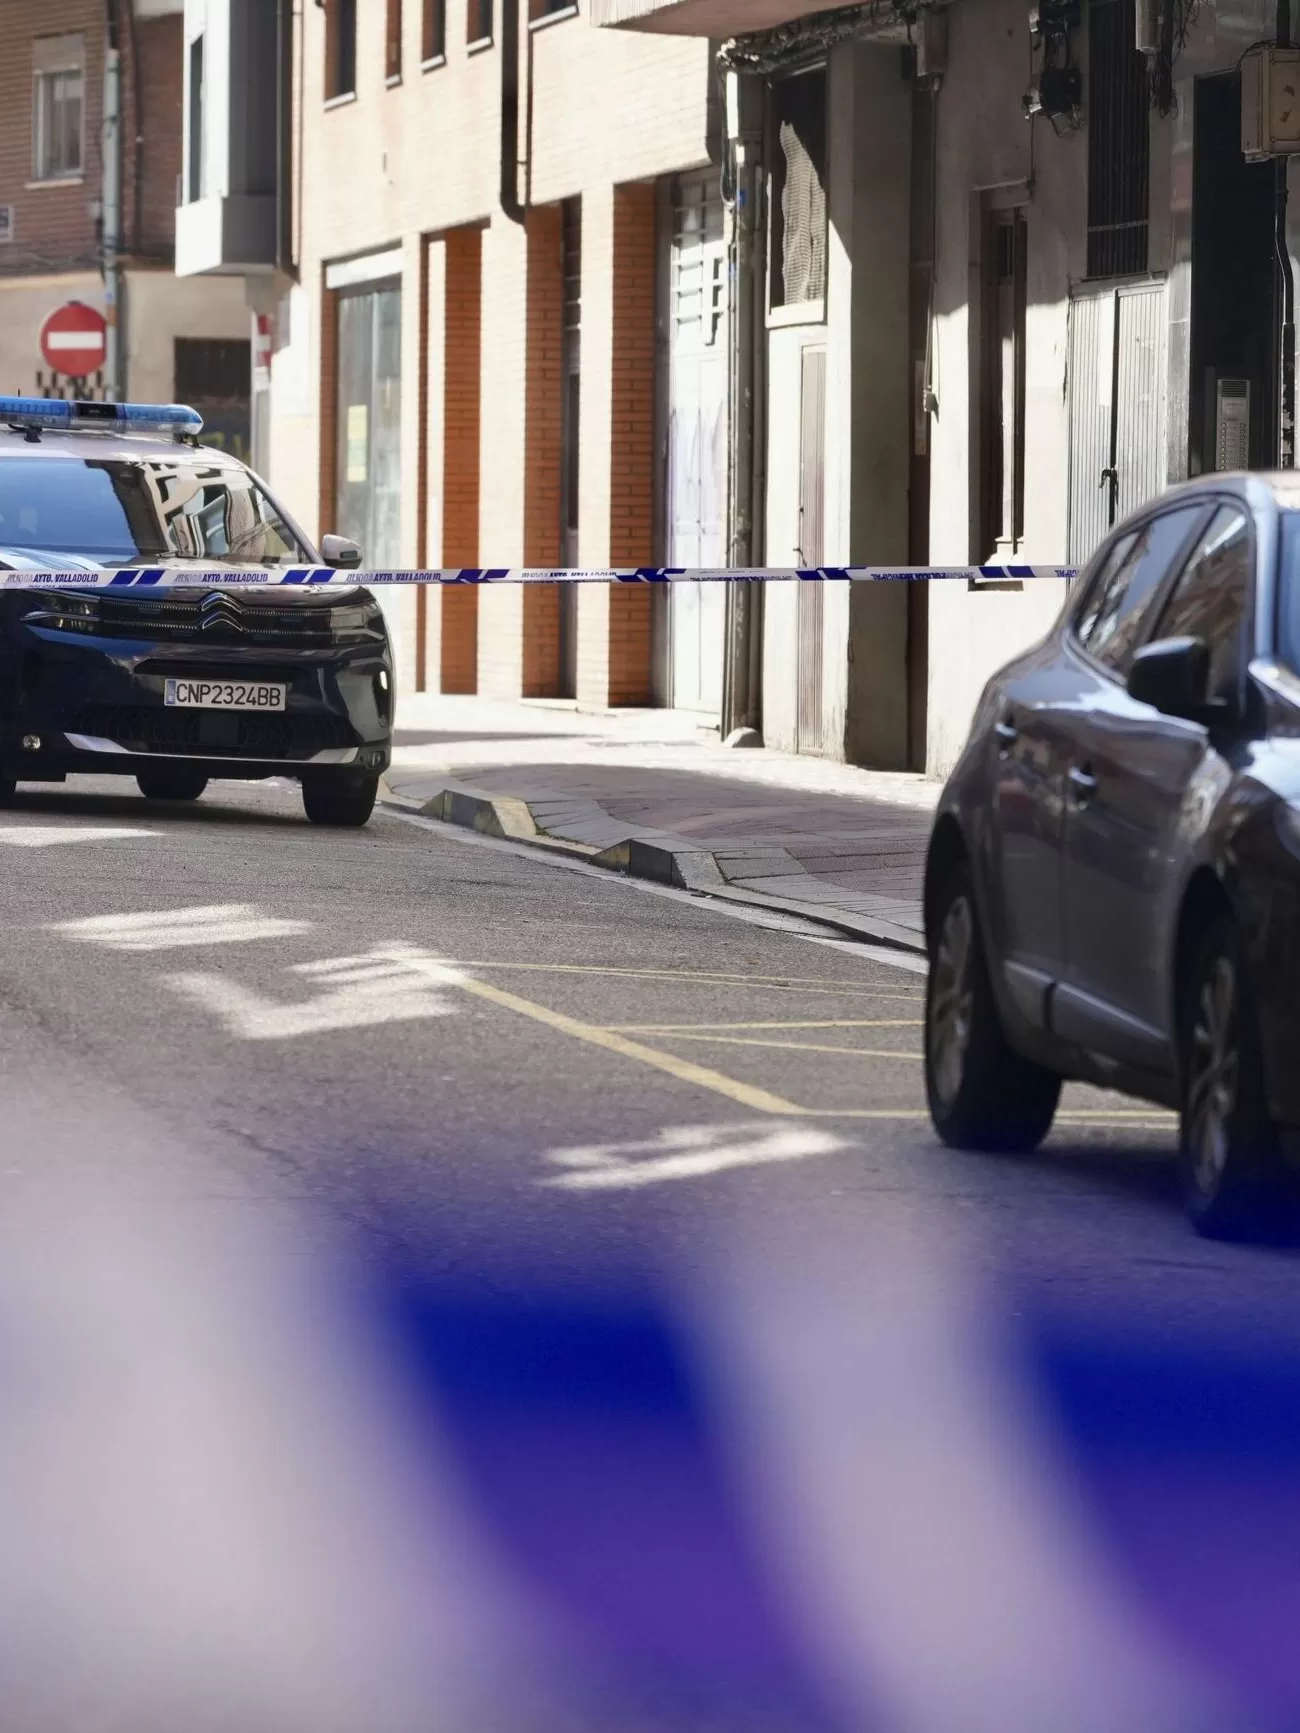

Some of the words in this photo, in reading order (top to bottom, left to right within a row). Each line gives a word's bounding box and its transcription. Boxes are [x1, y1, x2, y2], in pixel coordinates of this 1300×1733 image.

[33, 574, 53, 582] AYTO.
[55, 574, 98, 582] VALLADOLID
[202, 573, 222, 582] AYTO.
[224, 573, 268, 582] VALLADOLID
[176, 683, 281, 707] CNP2324BB
